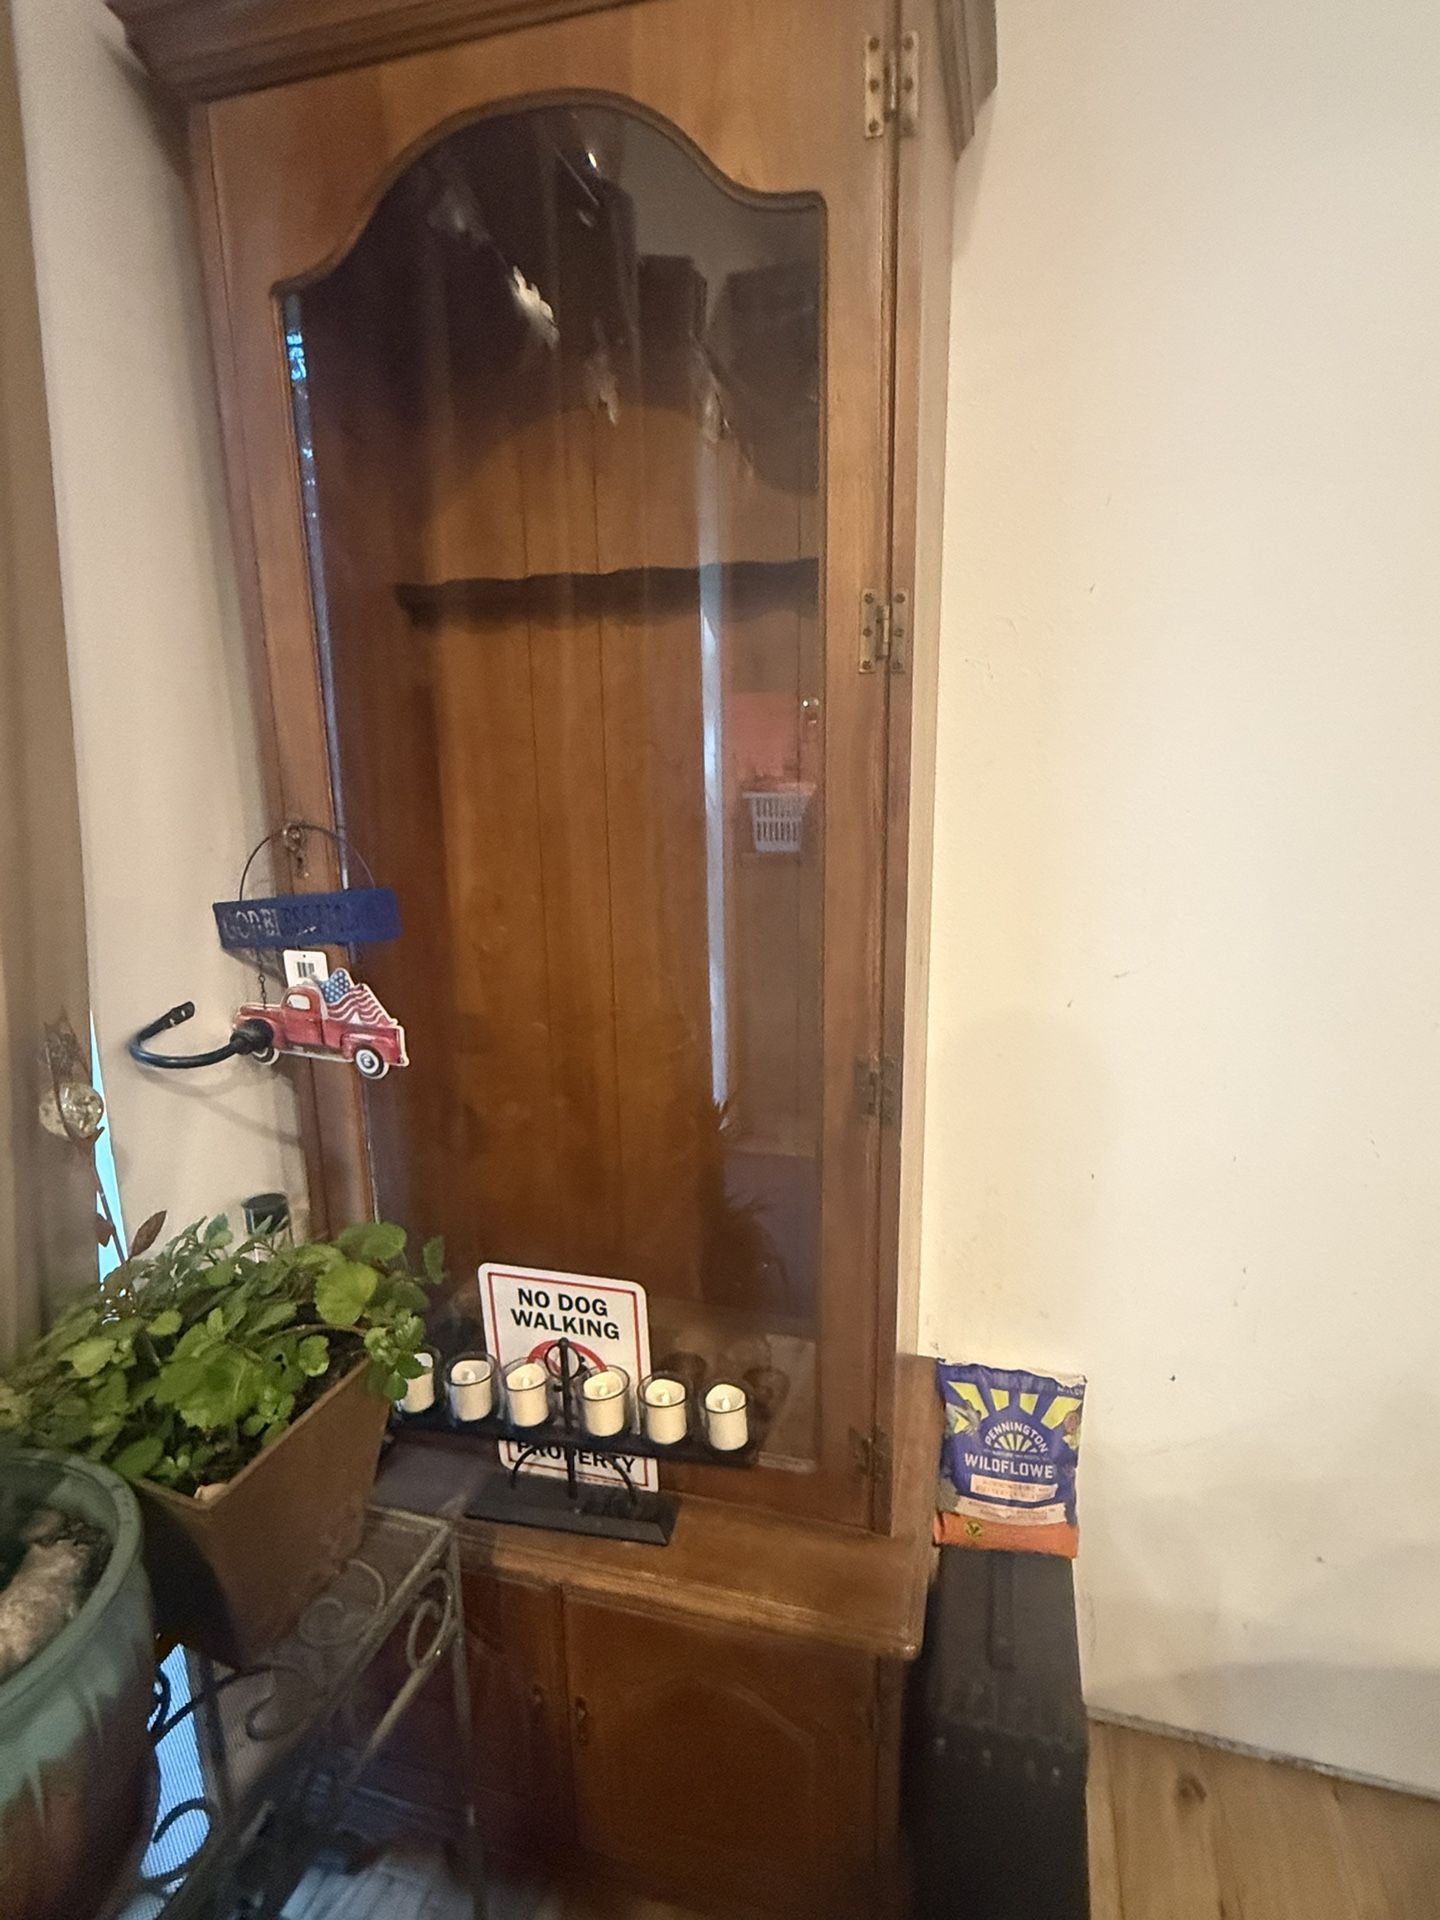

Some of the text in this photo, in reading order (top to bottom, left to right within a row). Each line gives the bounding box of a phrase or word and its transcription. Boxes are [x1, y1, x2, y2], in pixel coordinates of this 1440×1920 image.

[517, 1288, 608, 1317] NO DOG
[510, 1309, 620, 1340] WALKING
[984, 1421, 1049, 1453] PENNINGTON
[964, 1453, 1057, 1479] WILDFLOWE
